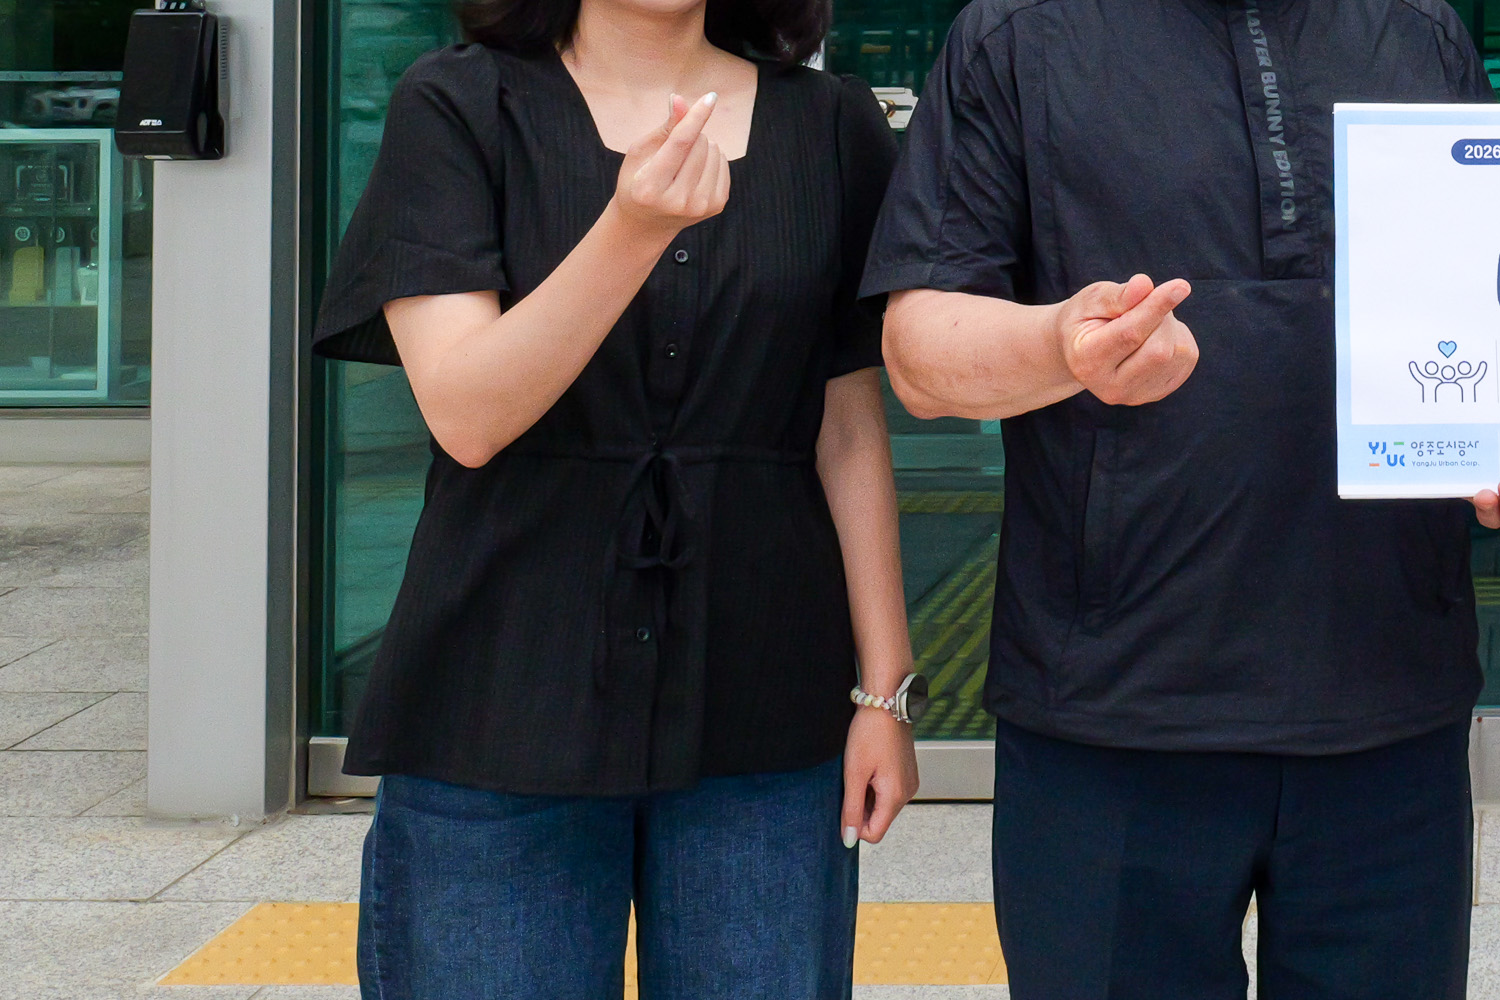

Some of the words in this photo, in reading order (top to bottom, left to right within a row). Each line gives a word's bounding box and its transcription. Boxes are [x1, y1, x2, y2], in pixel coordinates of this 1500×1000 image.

[1261, 71, 1286, 146] BUNNY
[1273, 150, 1297, 230] EDITION
[1410, 440, 1480, 457] 양주도시공사
